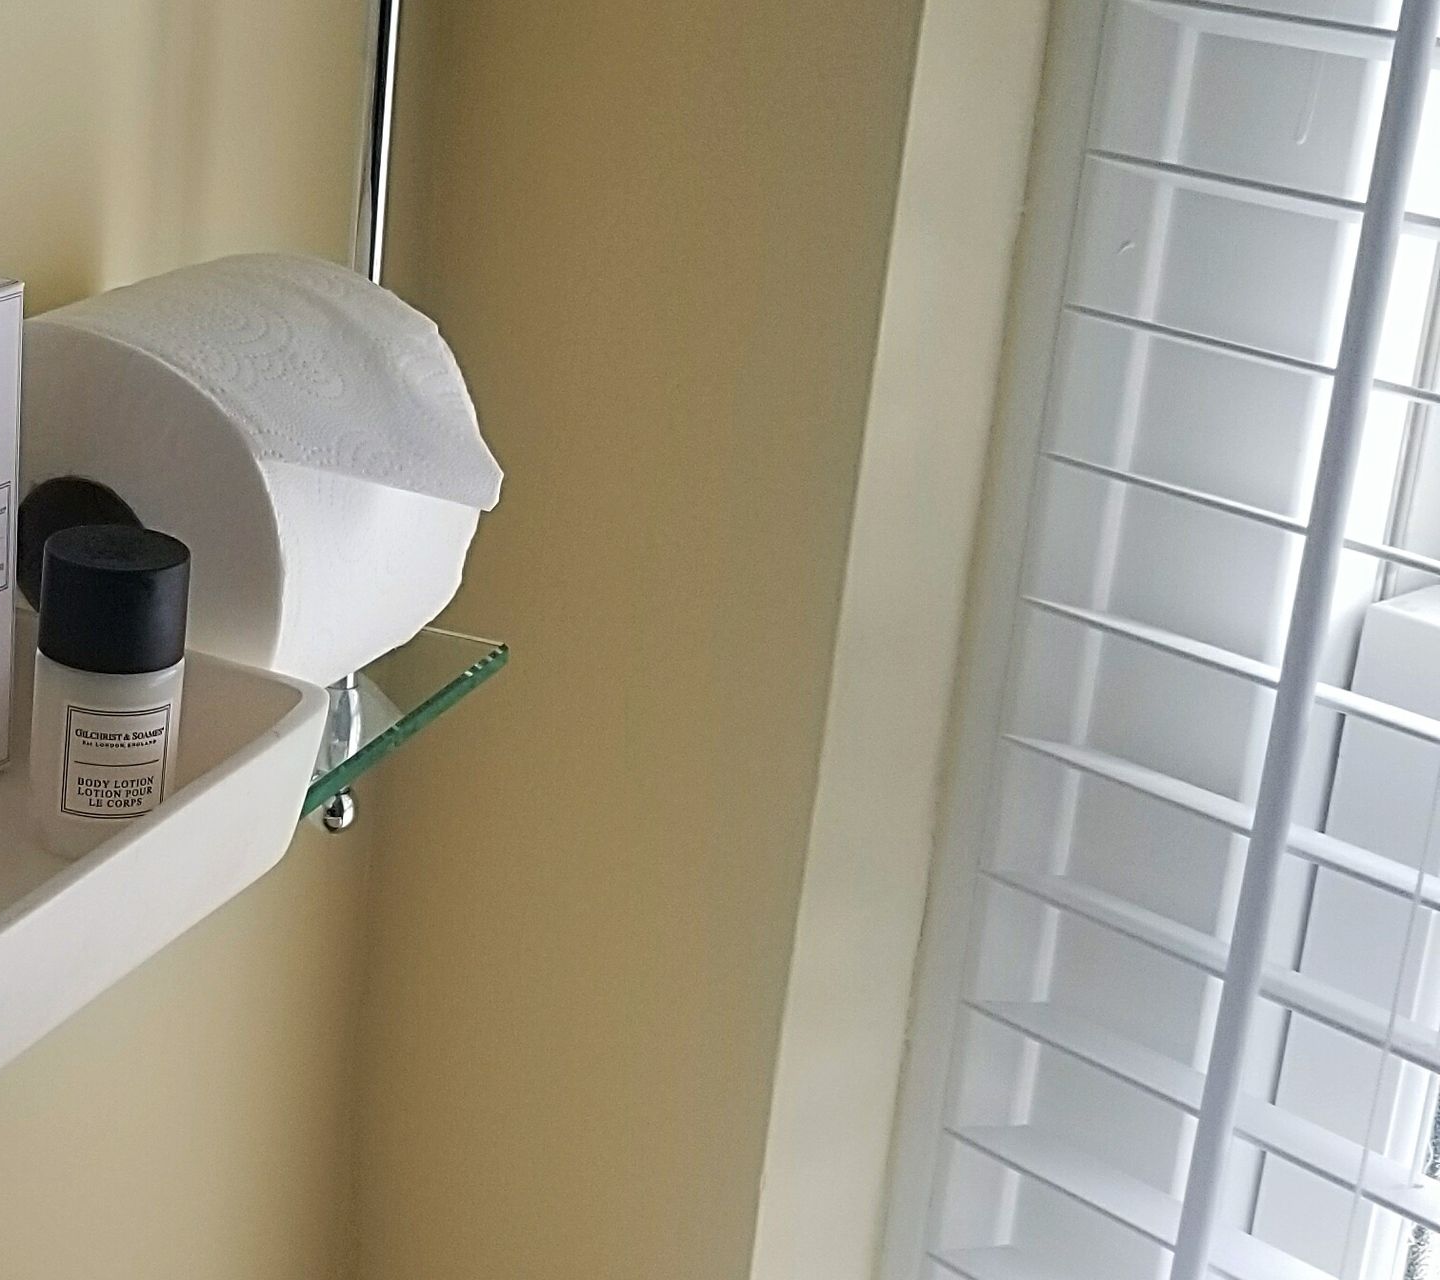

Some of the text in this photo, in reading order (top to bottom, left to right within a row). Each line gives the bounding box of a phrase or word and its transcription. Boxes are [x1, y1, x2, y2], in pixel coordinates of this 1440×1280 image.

[75, 729, 122, 741] GILCHRIST
[123, 732, 130, 741] &
[77, 776, 155, 789] BODY LOTION
[77, 786, 153, 798] LOTION POUR
[88, 797, 143, 808] LE CORPS
